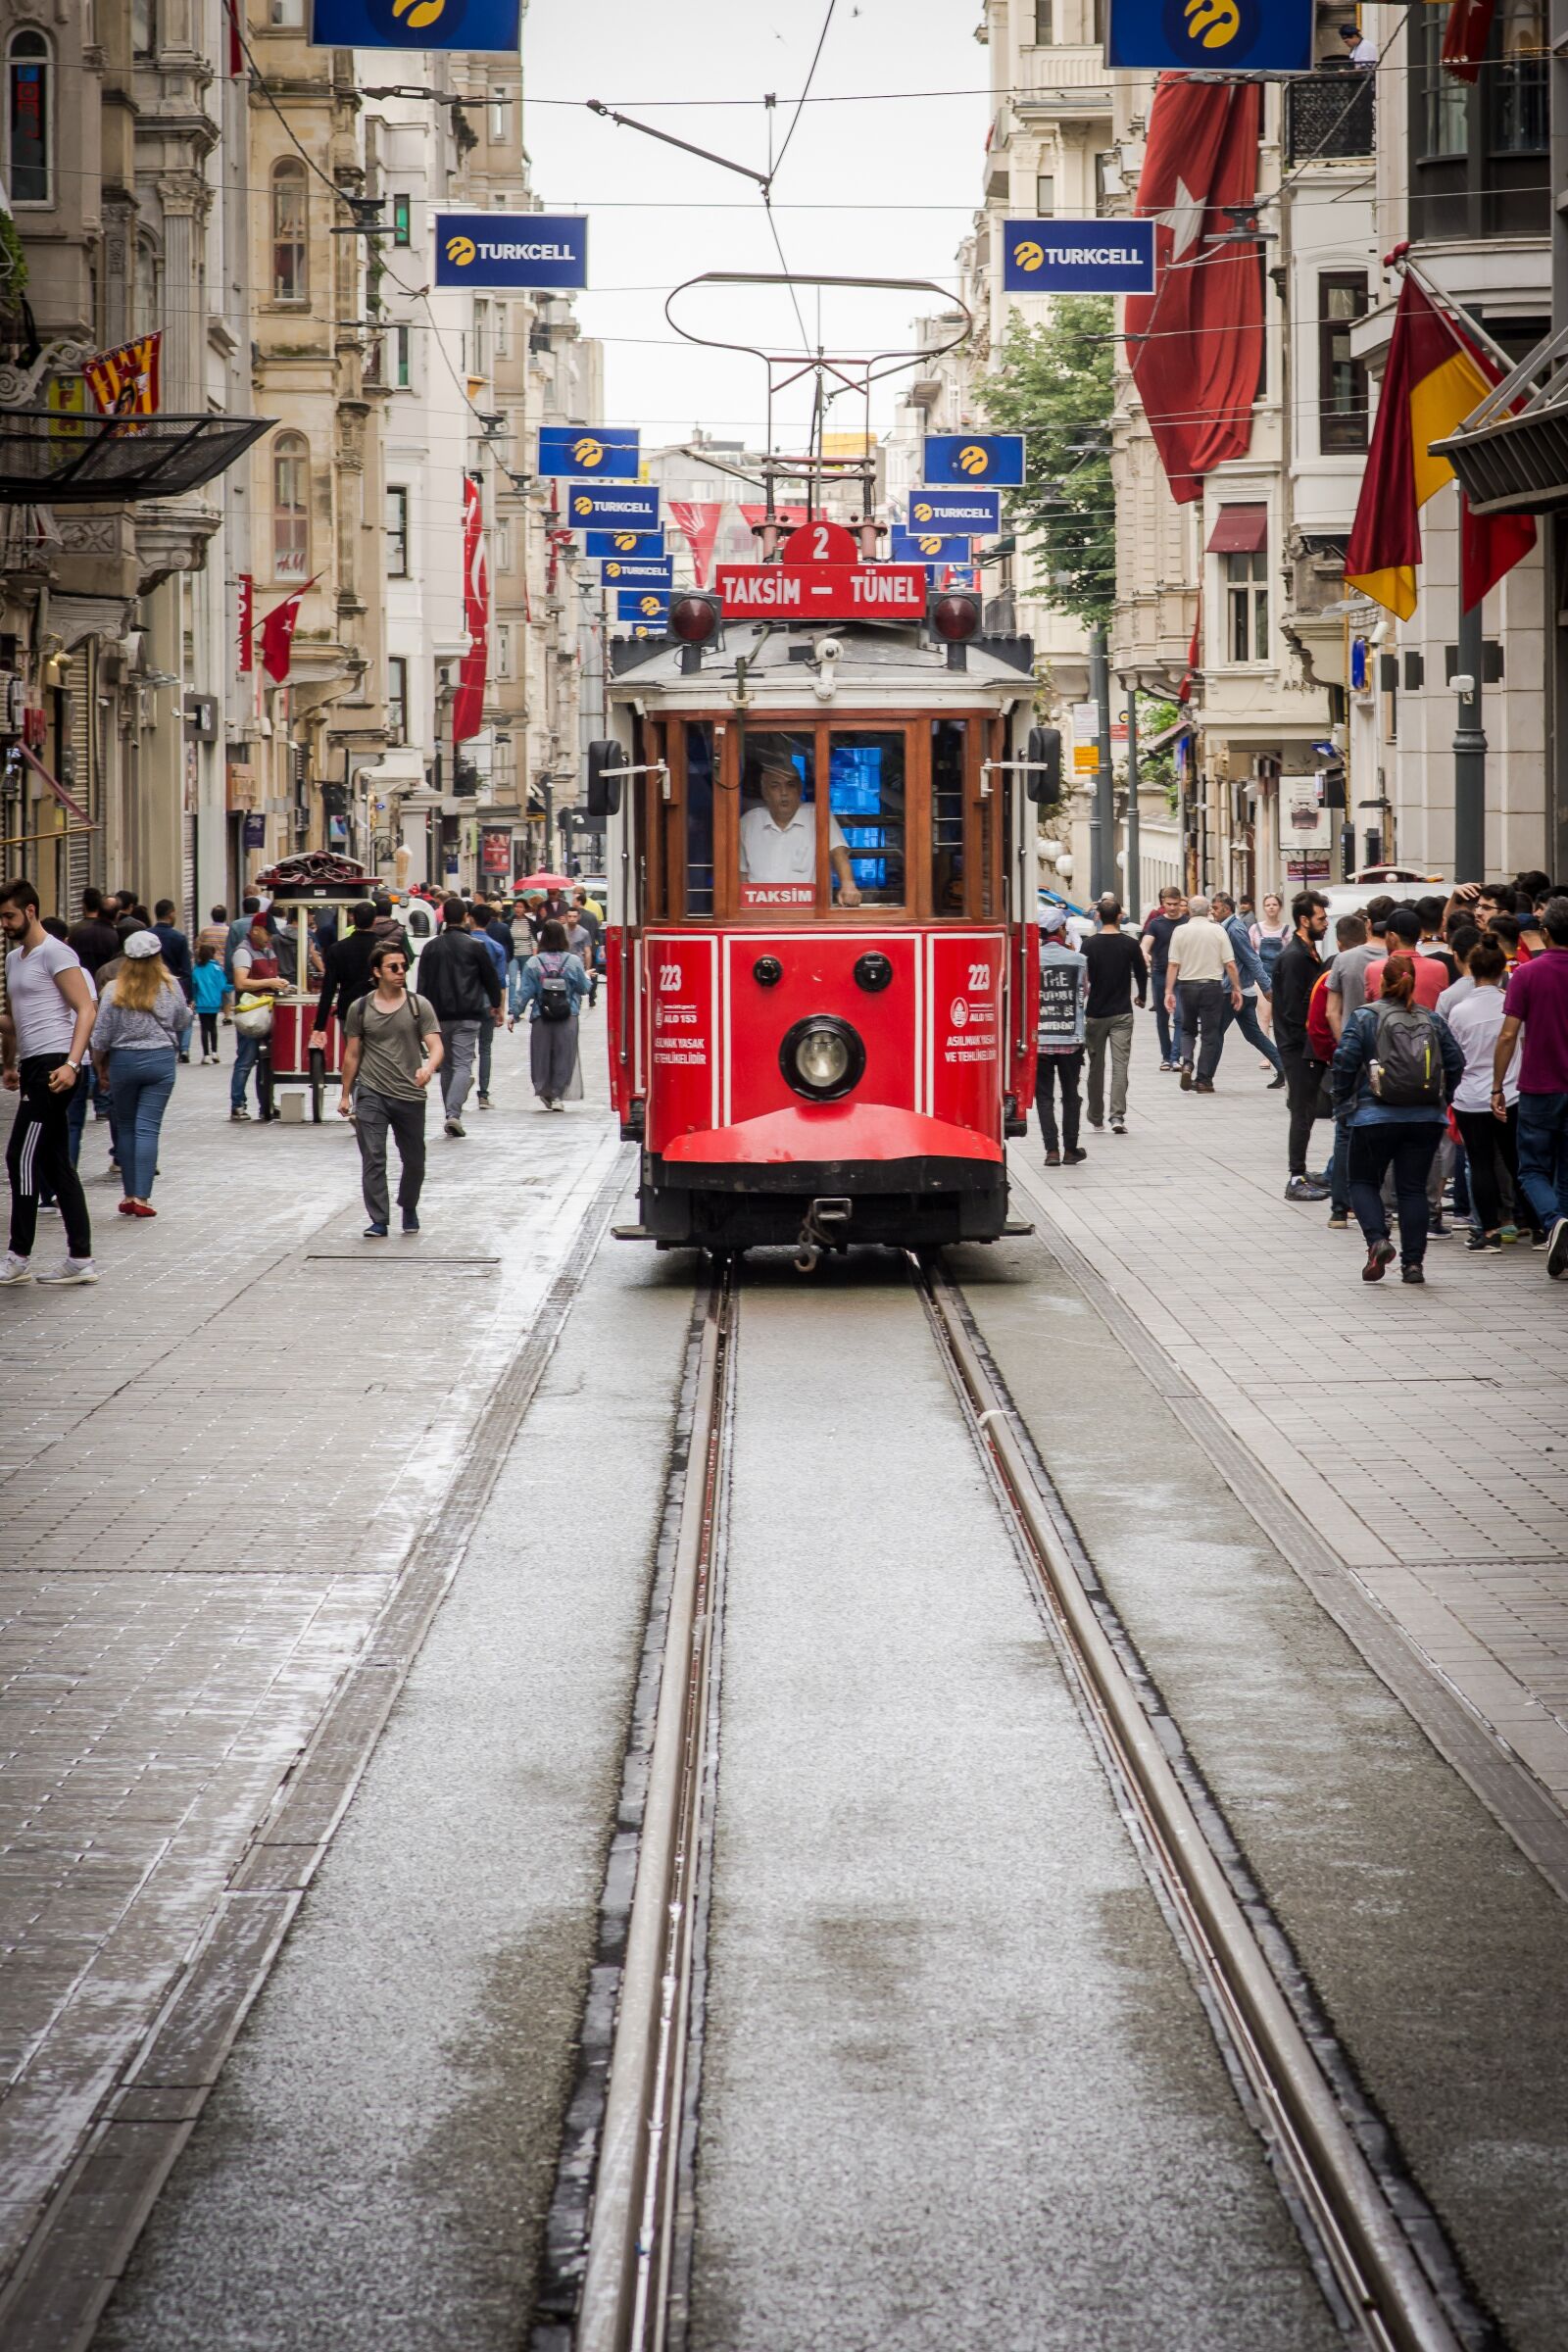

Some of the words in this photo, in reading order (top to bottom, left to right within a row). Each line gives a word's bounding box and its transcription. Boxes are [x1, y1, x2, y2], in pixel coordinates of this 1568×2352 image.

[477, 244, 576, 261] TURKCELL
[1045, 248, 1145, 265] TURKCELL
[593, 501, 654, 514] TURKCELL
[932, 507, 994, 518] TURKCELL
[812, 526, 829, 560] 2
[620, 565, 670, 576] TURKCELL
[721, 570, 801, 605] TAKSİM
[850, 568, 920, 603] TÜNEL
[744, 888, 812, 903] TAKSİM
[660, 964, 682, 991] 223
[967, 963, 990, 991] 223
[1040, 969, 1070, 988] THE
[680, 1014, 698, 1024] 153
